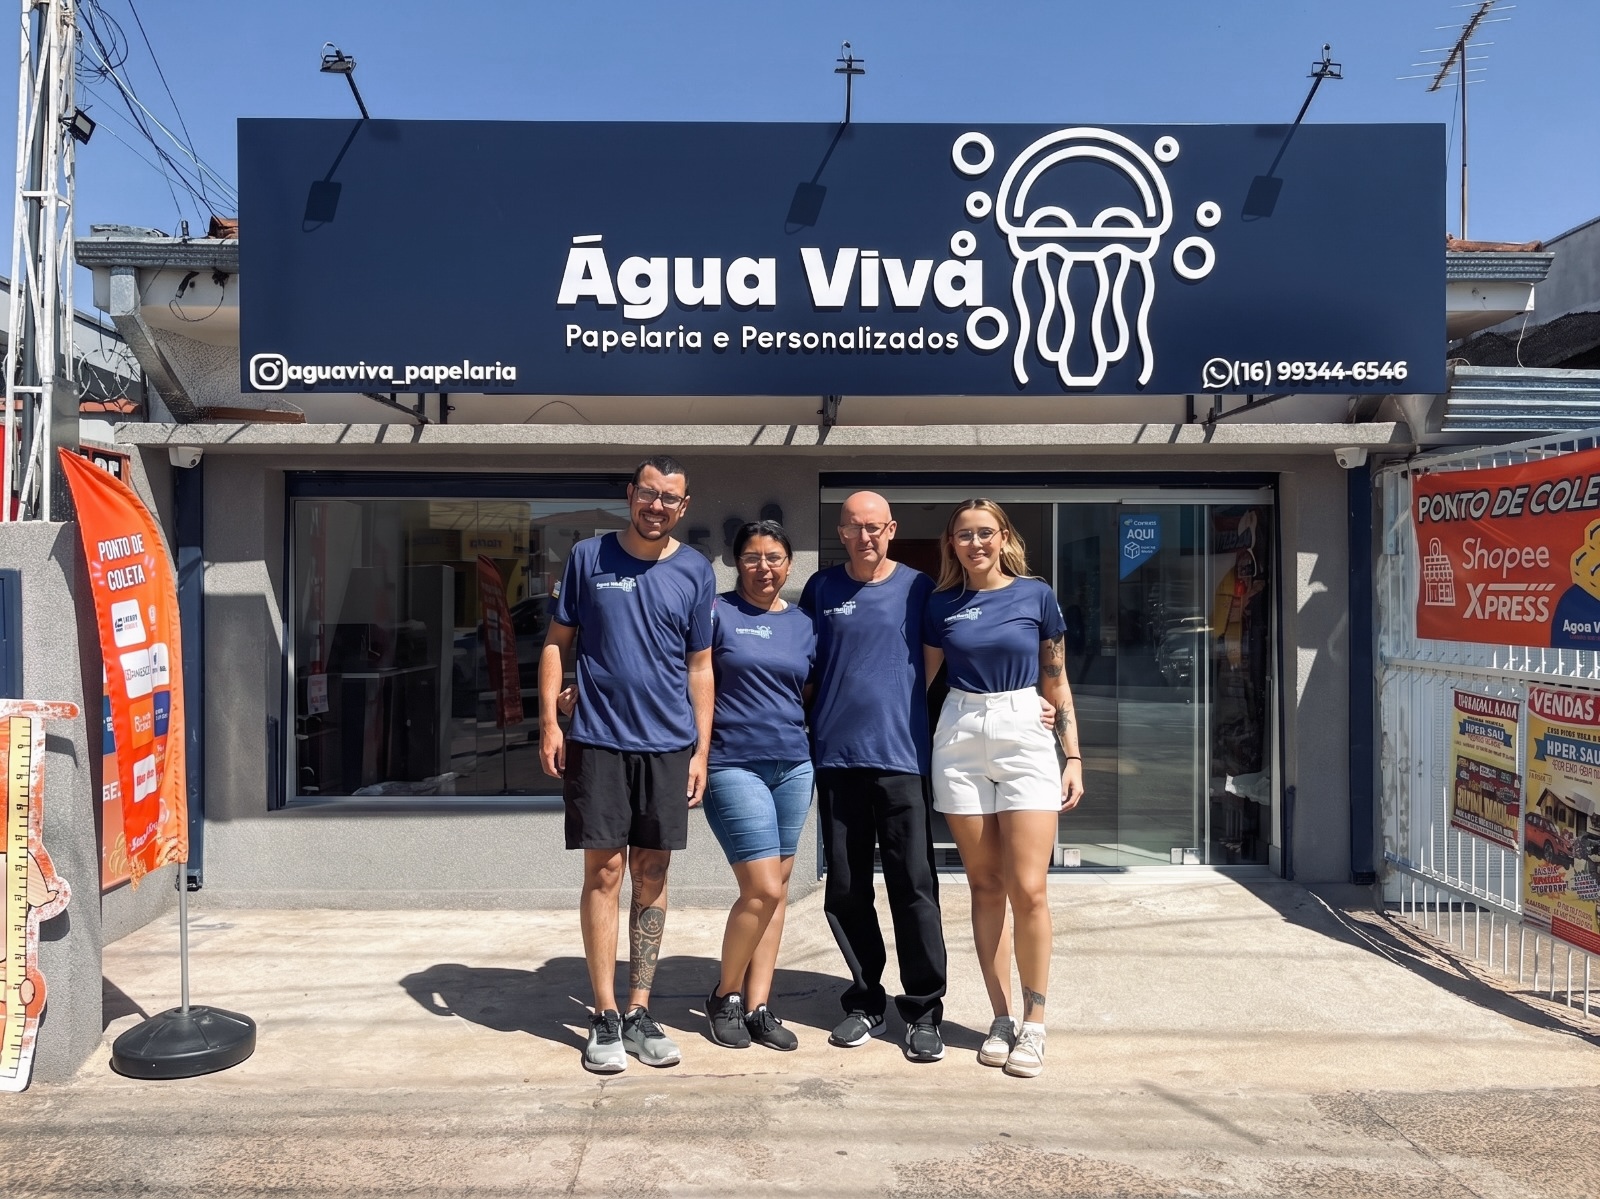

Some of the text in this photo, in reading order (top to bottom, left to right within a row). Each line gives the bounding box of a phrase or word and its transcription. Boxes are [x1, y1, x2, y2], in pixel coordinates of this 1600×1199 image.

[557, 235, 983, 320] Água Viva
[566, 324, 960, 353] Papelaria e Personalizados
[287, 360, 517, 385] aguaviva_papelaria
[1233, 360, 1408, 386] (16) 99344-6546
[1418, 475, 1600, 523] PONTO DE COLE
[98, 533, 145, 562] PONTO DE
[1126, 528, 1155, 541] AQUI
[1462, 537, 1550, 579] Shopee
[106, 564, 146, 592] COLETA
[1462, 583, 1551, 623] XPRESS
[1531, 689, 1595, 721] VENDAS
